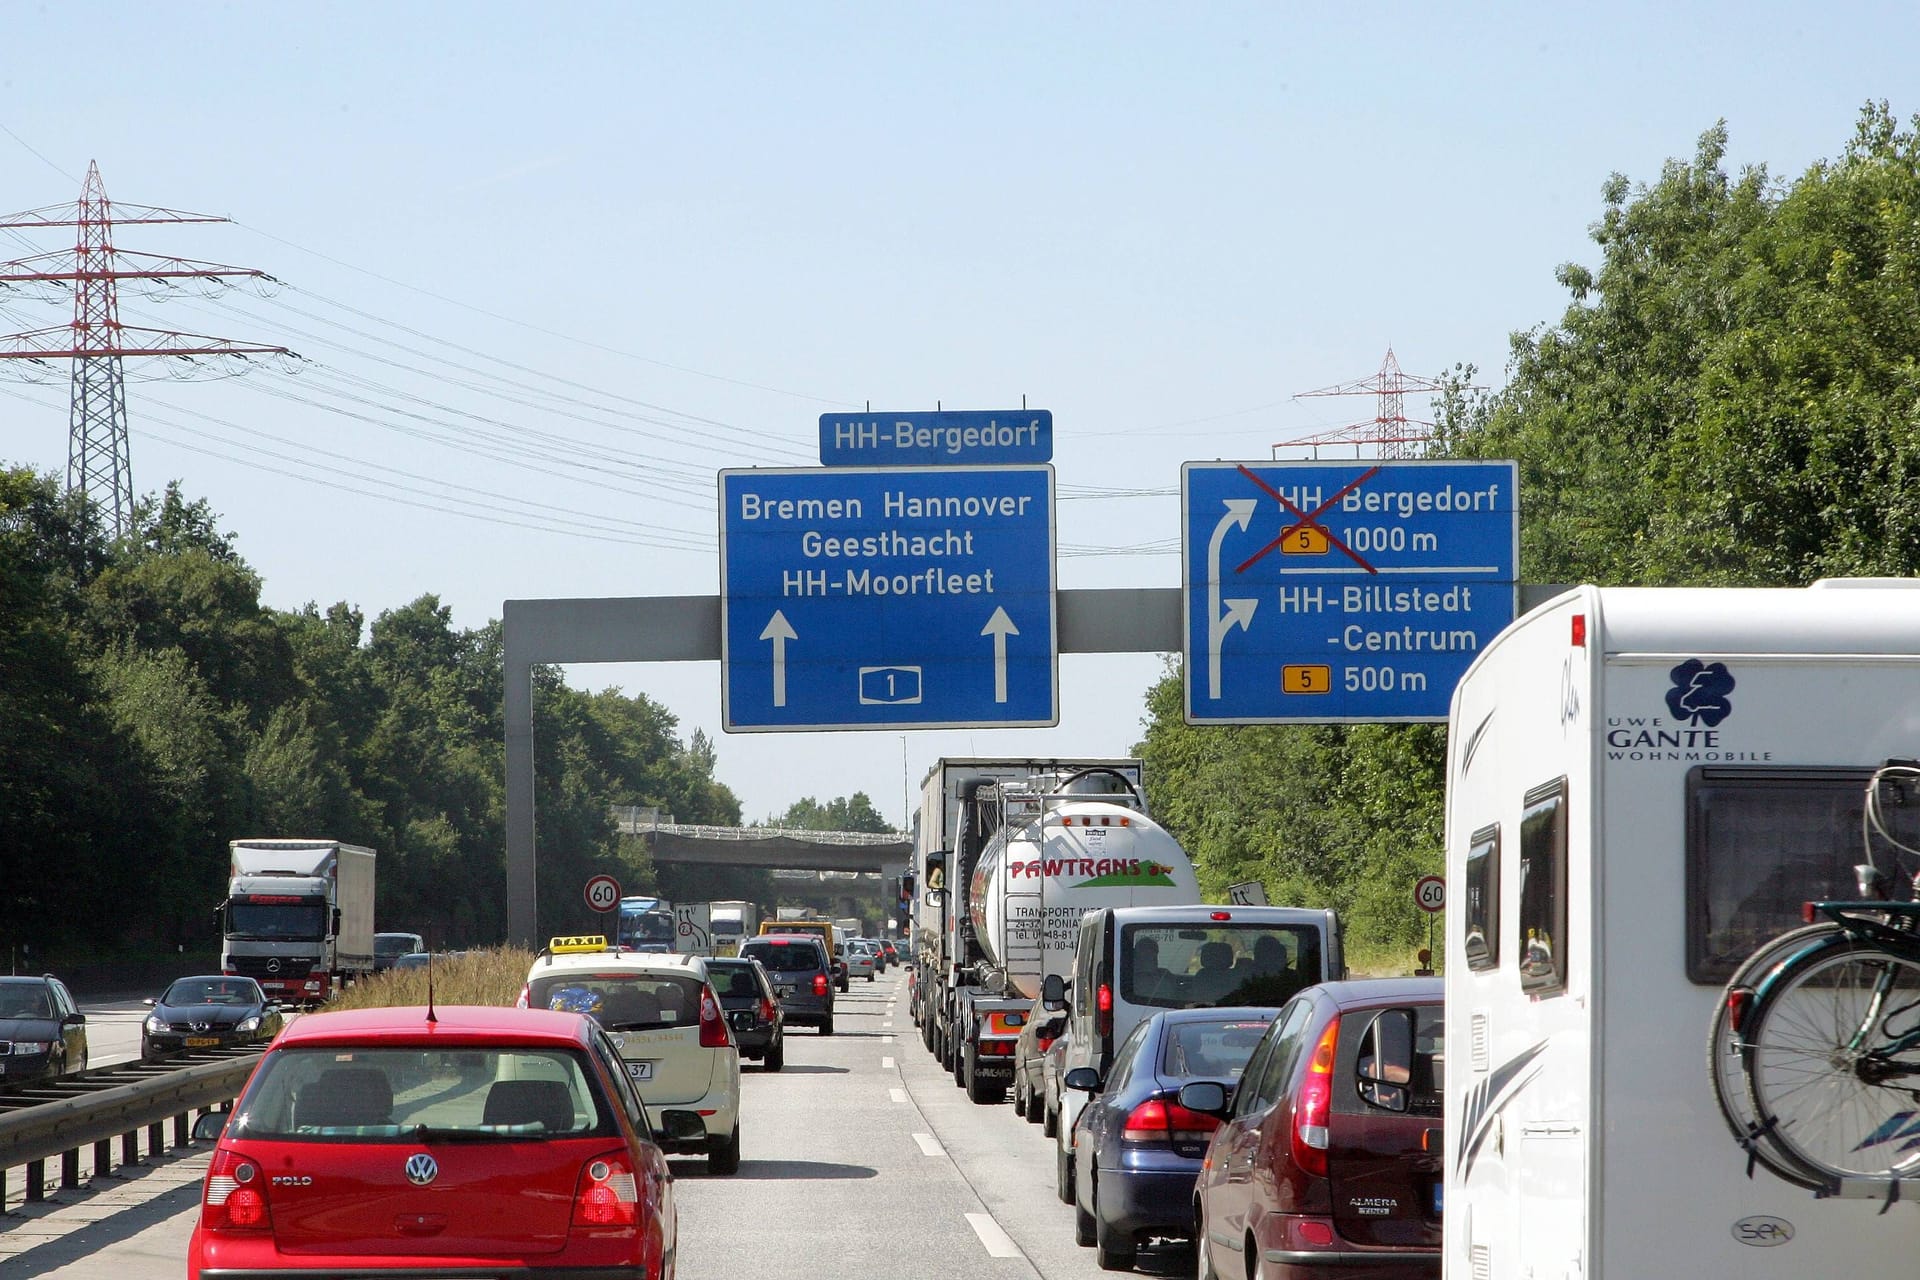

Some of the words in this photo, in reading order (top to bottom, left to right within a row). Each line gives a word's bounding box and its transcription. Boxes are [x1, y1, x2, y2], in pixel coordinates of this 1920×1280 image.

[834, 419, 1039, 453] HH-Bergedorf
[741, 494, 863, 520] Bremen
[884, 491, 1031, 518] Hannover
[802, 529, 974, 557] Geesthacht
[1299, 532, 1310, 549] 5
[1344, 527, 1406, 551] 1000
[1412, 532, 1438, 551] m
[783, 568, 994, 596] HH-Moorfleet
[1279, 586, 1472, 613] HH-Billstedt
[1327, 625, 1477, 651] -Centrum
[886, 674, 895, 697] 1
[1301, 671, 1312, 688] 5
[1344, 667, 1395, 691] 500
[1401, 671, 1427, 691] m
[1608, 717, 1662, 727] UWE
[1607, 729, 1720, 748] GANTE
[1608, 751, 1773, 761] WOHNMOBILE
[1011, 858, 1141, 879] PAWTRANS
[593, 886, 613, 902] 60
[1423, 886, 1443, 902] 60
[560, 936, 597, 946] TAXI
[1015, 931, 1029, 940] tel.
[631, 1064, 646, 1076] 37
[272, 1176, 312, 1186] POLO
[1349, 1198, 1398, 1207] ALMERA
